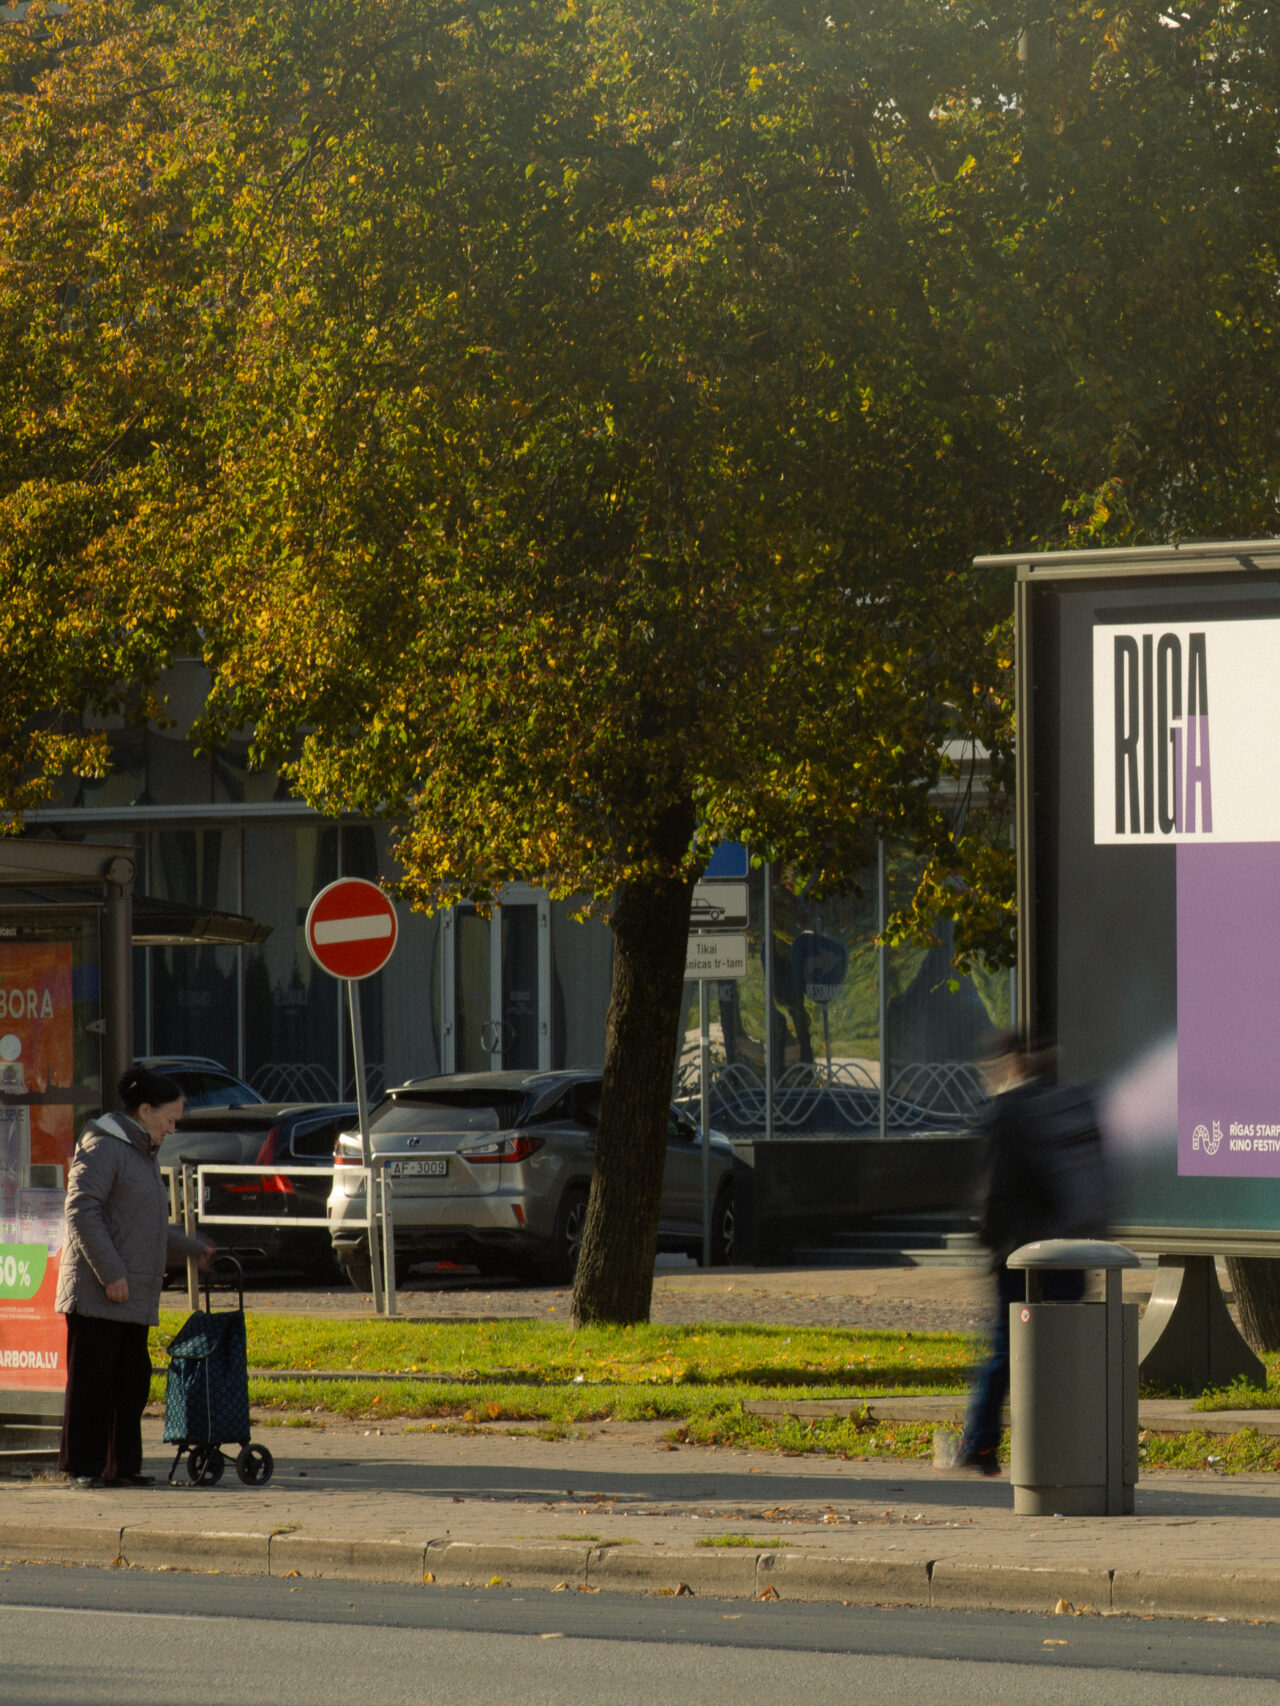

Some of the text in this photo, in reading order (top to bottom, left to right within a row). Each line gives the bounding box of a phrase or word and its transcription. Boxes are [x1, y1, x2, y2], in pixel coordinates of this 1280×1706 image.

[1114, 632, 1213, 834] RIGA
[696, 943, 718, 955] Tikai
[714, 957, 744, 969] tr-tam
[1229, 1121, 1255, 1137] RĪGAS
[1229, 1139, 1252, 1152] KINO
